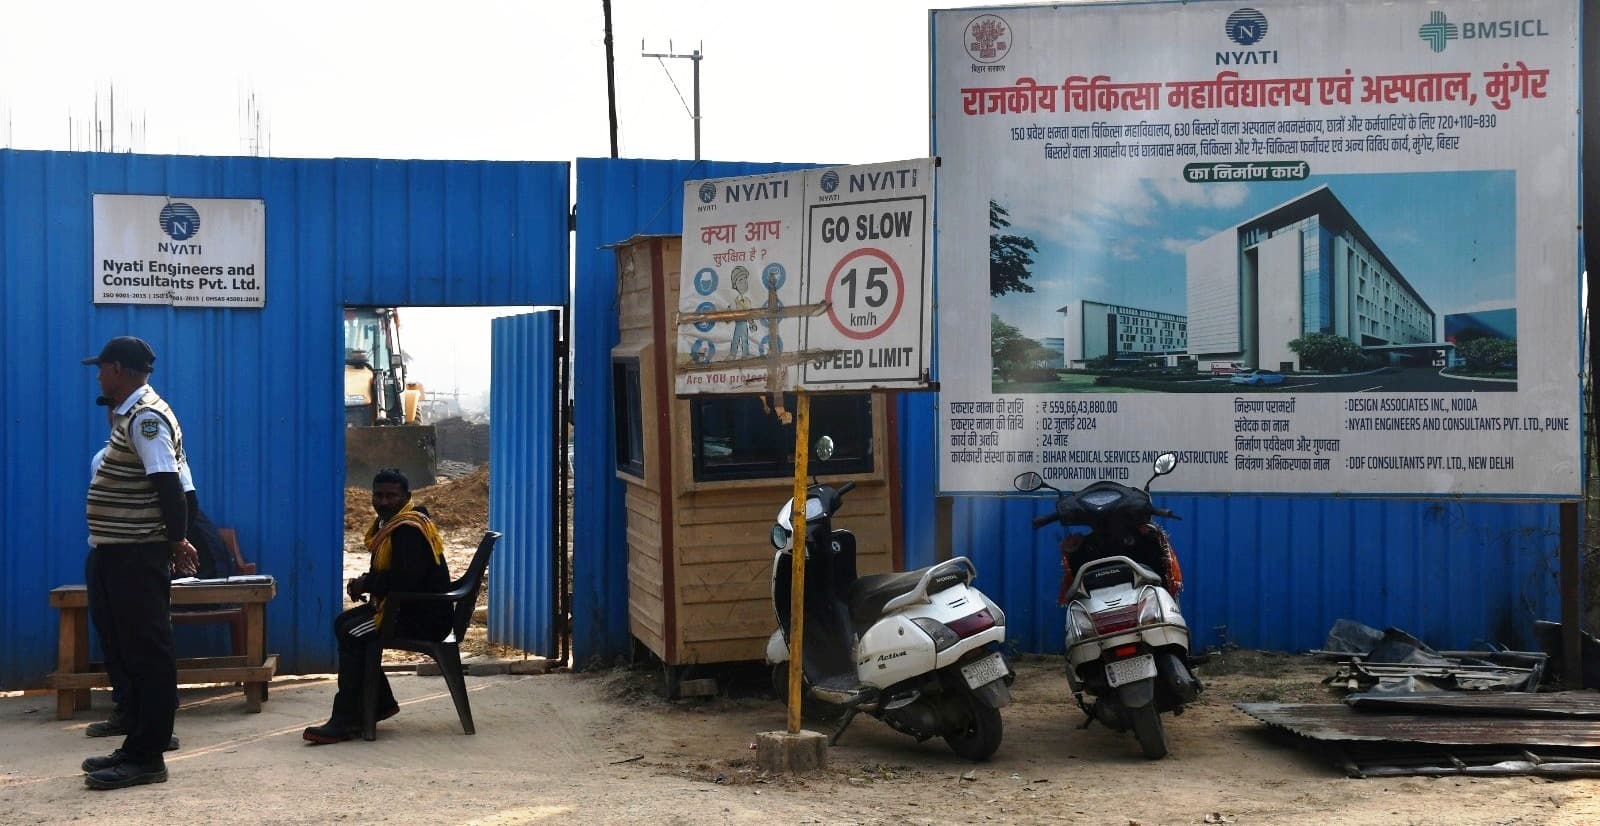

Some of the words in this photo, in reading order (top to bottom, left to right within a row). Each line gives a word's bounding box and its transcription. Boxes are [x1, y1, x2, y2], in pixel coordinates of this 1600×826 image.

[1238, 26, 1254, 38] N
[1462, 20, 1548, 39] BMSICL
[1216, 50, 1277, 65] NYATI
[961, 76, 1058, 116] राजकीय
[1062, 75, 1161, 112] चिकित्सा
[1166, 71, 1312, 110] महाविद्यालय
[1317, 69, 1353, 104] एवं
[1362, 72, 1476, 106] अस्पताल,
[1484, 61, 1549, 110] मुंगेर
[1011, 128, 1024, 140] 150
[1027, 124, 1045, 140] प्रवेश
[1048, 126, 1070, 139] क्षमता
[1071, 126, 1090, 138] वाला
[1092, 122, 1122, 138] चिकित्सा
[1124, 120, 1172, 138] महाविद्यालय,
[1174, 123, 1190, 136] 630
[1192, 119, 1220, 136] बिस्तरों
[1220, 122, 1240, 136] वाला
[1242, 121, 1276, 134] अस्पताल
[1326, 116, 1346, 132] छात्रों
[1348, 115, 1362, 131] और
[1365, 114, 1407, 131] कर्मचारियों
[1408, 114, 1417, 130] के
[1419, 112, 1436, 130] लिए
[1438, 114, 1496, 129] 720+110=830
[1045, 142, 1071, 160] बिस्तरों
[1072, 146, 1091, 158] वाला
[1093, 141, 1126, 158] आवासीय
[1128, 142, 1139, 158] एवं
[1141, 144, 1174, 157] छात्रावास
[1176, 144, 1198, 158] भवन,
[1200, 139, 1232, 156] चिकित्सा
[1234, 138, 1250, 155] और
[1252, 137, 1298, 154] गैर-चिकित्सा
[1300, 136, 1330, 154] फर्नीचर
[1332, 136, 1343, 152] एवं
[1345, 139, 1364, 152] अन्य
[1366, 134, 1389, 152] विविध
[1391, 134, 1410, 152] कार्य,
[1412, 134, 1434, 154] मुंगेर,
[1437, 133, 1460, 150] बिहार
[1188, 168, 1210, 180] का
[1212, 164, 1268, 180] निर्माण
[1270, 162, 1306, 178] कार्य
[850, 169, 917, 192] NYATI
[726, 180, 788, 203] NYATI
[701, 224, 737, 245] क्या
[745, 220, 782, 242] आप
[822, 217, 850, 243] GO
[856, 211, 912, 240] SLOW
[158, 242, 202, 255] NYATI
[712, 249, 745, 267] सुरक्षित
[103, 260, 144, 274] Nyati
[149, 261, 222, 276] Engineers
[228, 264, 254, 276] and
[103, 274, 194, 290] Consultants
[199, 278, 227, 290] Pvt.
[232, 279, 260, 290] Ltd.
[841, 267, 889, 308] 15
[850, 313, 877, 327] km/h
[869, 347, 913, 368] LIMIT
[686, 375, 703, 385] Are
[706, 374, 726, 384] YOU
[950, 402, 974, 414] एकरार
[976, 402, 994, 413] नामा
[996, 398, 1005, 413] की
[1007, 398, 1024, 414] राशि
[1050, 401, 1118, 415] 559,66,43,880.00
[1380, 398, 1428, 411] ASSOCIATES
[1452, 398, 1478, 411] NOIDA
[950, 418, 974, 431] एकरार
[976, 418, 994, 430] नामा
[996, 415, 1005, 430] की
[1007, 415, 1024, 430] तिथि
[1042, 418, 1052, 430] 02
[1054, 414, 1076, 433] जुलाई
[1077, 418, 1096, 430] 2024
[1234, 416, 1259, 432] संवेदक
[1261, 420, 1271, 432] का
[1272, 420, 1290, 432] नाम
[1375, 418, 1420, 430] ENGINEERS
[1422, 418, 1440, 430] AND
[1442, 418, 1501, 430] CONSULTANTS
[1504, 418, 1522, 430] PVT.
[1546, 418, 1568, 430] PUNE
[950, 431, 966, 446] कार्य
[968, 431, 977, 446] की
[980, 431, 999, 446] अवधि
[1042, 434, 1052, 446] 24
[1053, 434, 1068, 446] माह
[1234, 435, 1261, 452] निर्माण
[1296, 435, 1311, 452] और
[950, 448, 982, 463] कार्यकारी
[1006, 451, 1016, 463] का
[1017, 451, 1033, 463] नाम
[1042, 451, 1067, 463] BIHAR
[1068, 450, 1103, 463] MEDICAL
[1104, 450, 1140, 463] SERVICES
[1142, 450, 1158, 463] AND
[1234, 455, 1264, 470] नियंत्रण
[1312, 459, 1330, 470] नाम
[1367, 456, 1425, 469] CONSULTANTS
[1427, 456, 1445, 469] PVT.
[1468, 456, 1487, 470] NEW
[1489, 456, 1514, 470] DELHI
[1042, 467, 1097, 480] CORPORATION
[1100, 466, 1129, 480] LIMITED
[878, 651, 907, 662] Activa
